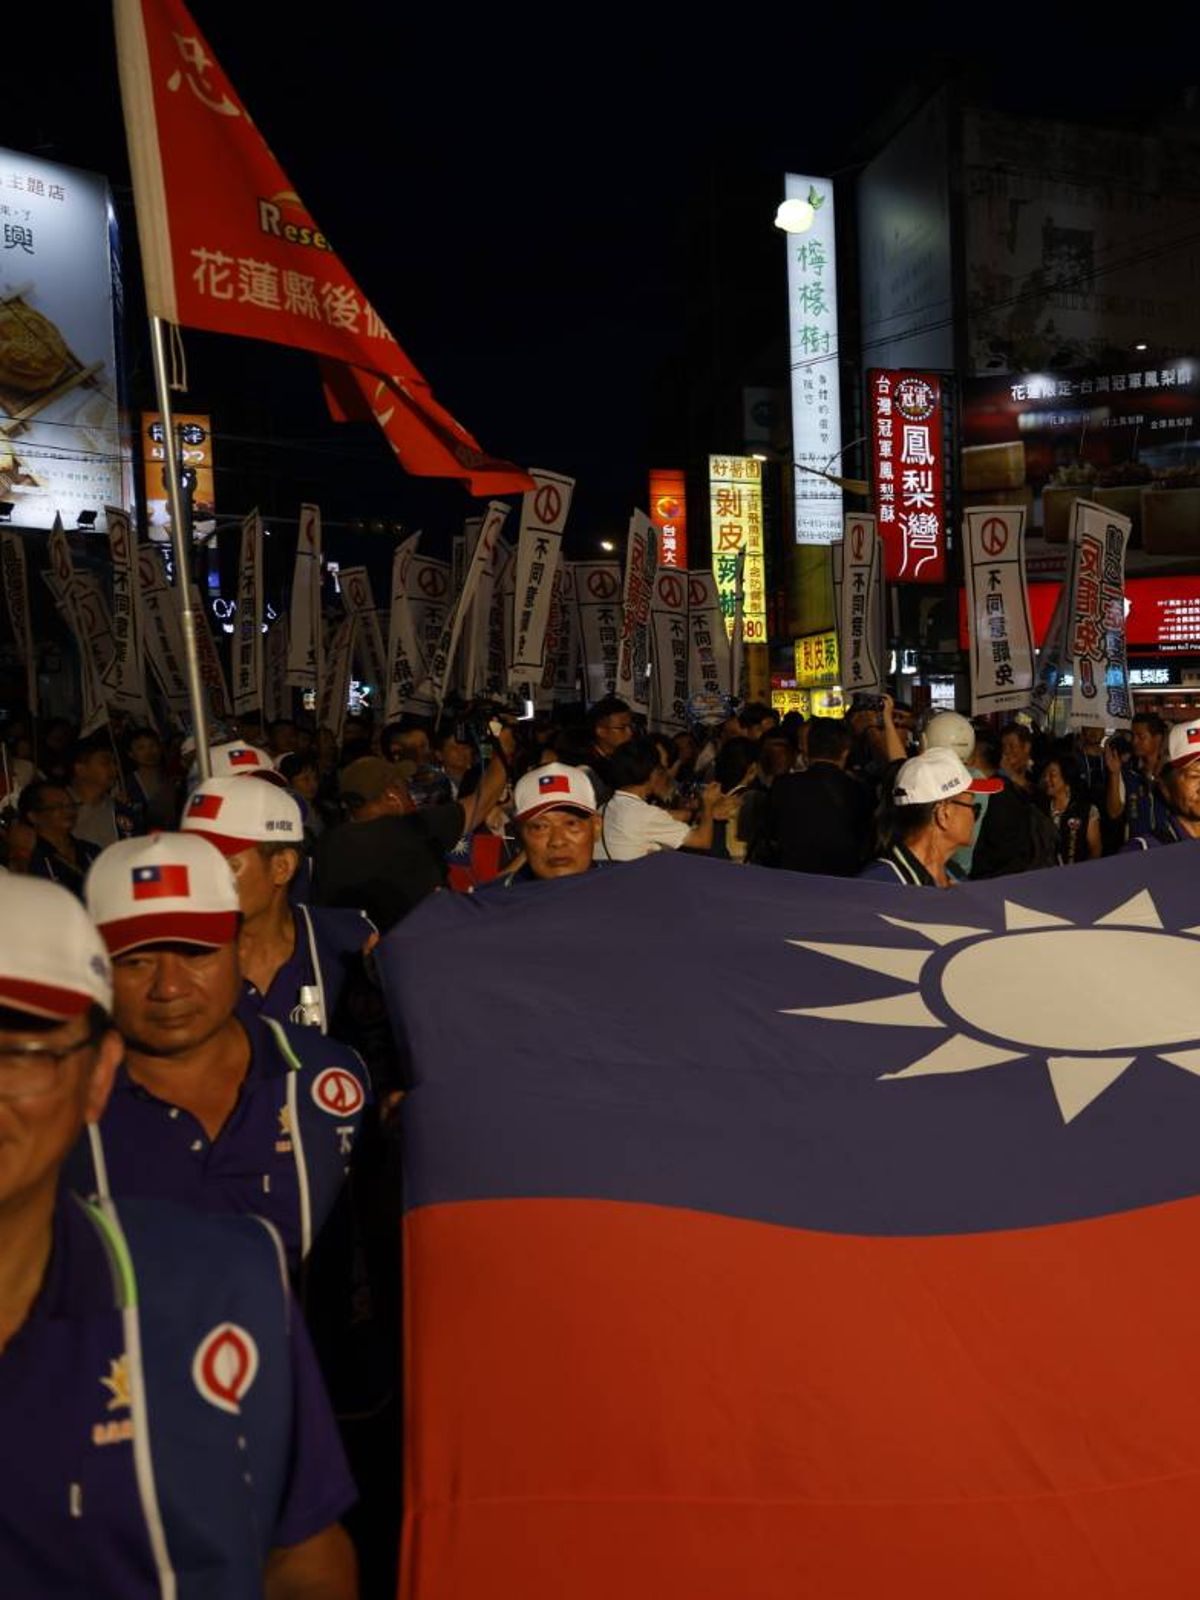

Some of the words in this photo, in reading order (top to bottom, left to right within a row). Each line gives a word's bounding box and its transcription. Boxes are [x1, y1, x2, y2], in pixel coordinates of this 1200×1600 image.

[258, 199, 334, 252] Rese
[797, 239, 830, 354] 檸檬樹
[876, 375, 895, 523] 台灣冠軍鳳梨酥
[899, 425, 939, 577] 鳳梨灣
[662, 524, 678, 567] 台灣大
